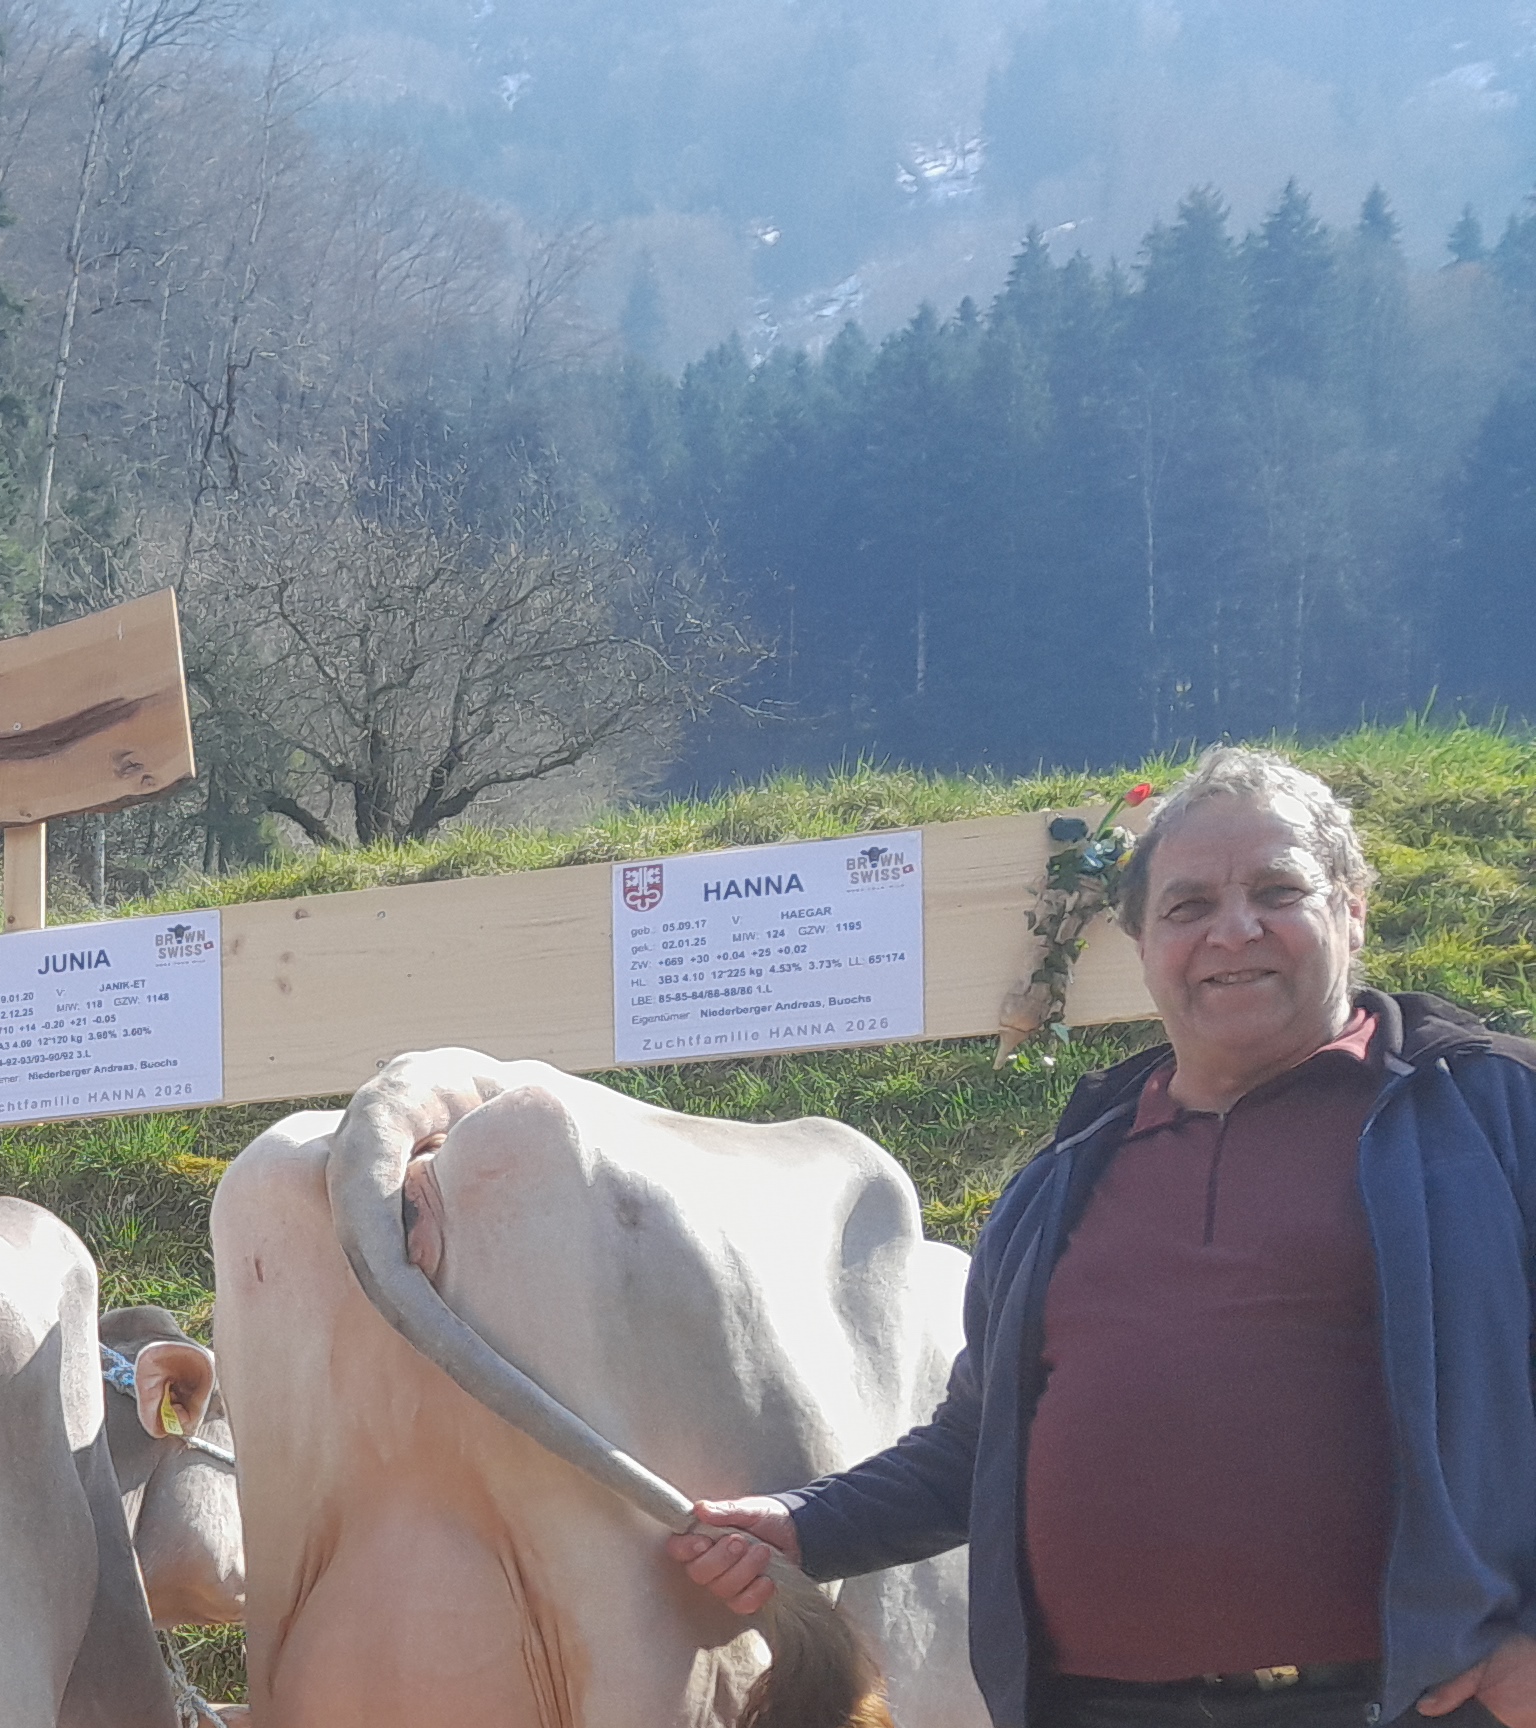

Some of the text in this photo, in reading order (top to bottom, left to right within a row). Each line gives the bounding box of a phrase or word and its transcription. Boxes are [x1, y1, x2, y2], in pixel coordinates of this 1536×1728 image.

[850, 868, 901, 885] SWISS
[703, 874, 804, 902] HANNA
[781, 907, 832, 920] HAEGAR
[662, 937, 706, 949] 02.01.25
[766, 929, 785, 939] 124
[158, 944, 202, 960] SWISS
[690, 954, 709, 963] +30
[717, 952, 745, 960] +0.04
[778, 945, 807, 954] +0.02
[38, 950, 111, 975] JUNIA
[682, 972, 704, 981] 4.10
[749, 968, 762, 977] kg
[809, 959, 842, 970] 3.73%
[756, 984, 772, 993] 1.L
[700, 1002, 772, 1019] Niederberger
[775, 1000, 825, 1012] Andreas,
[828, 995, 871, 1006] Buochs
[70, 1018, 86, 1026] +21
[71, 1035, 82, 1044] kg
[643, 1018, 889, 1051] Zuchtfamilie HANNA 2026
[140, 1059, 178, 1069] Buochs
[88, 1087, 146, 1103] HANNA
[155, 1083, 193, 1096] 2026
